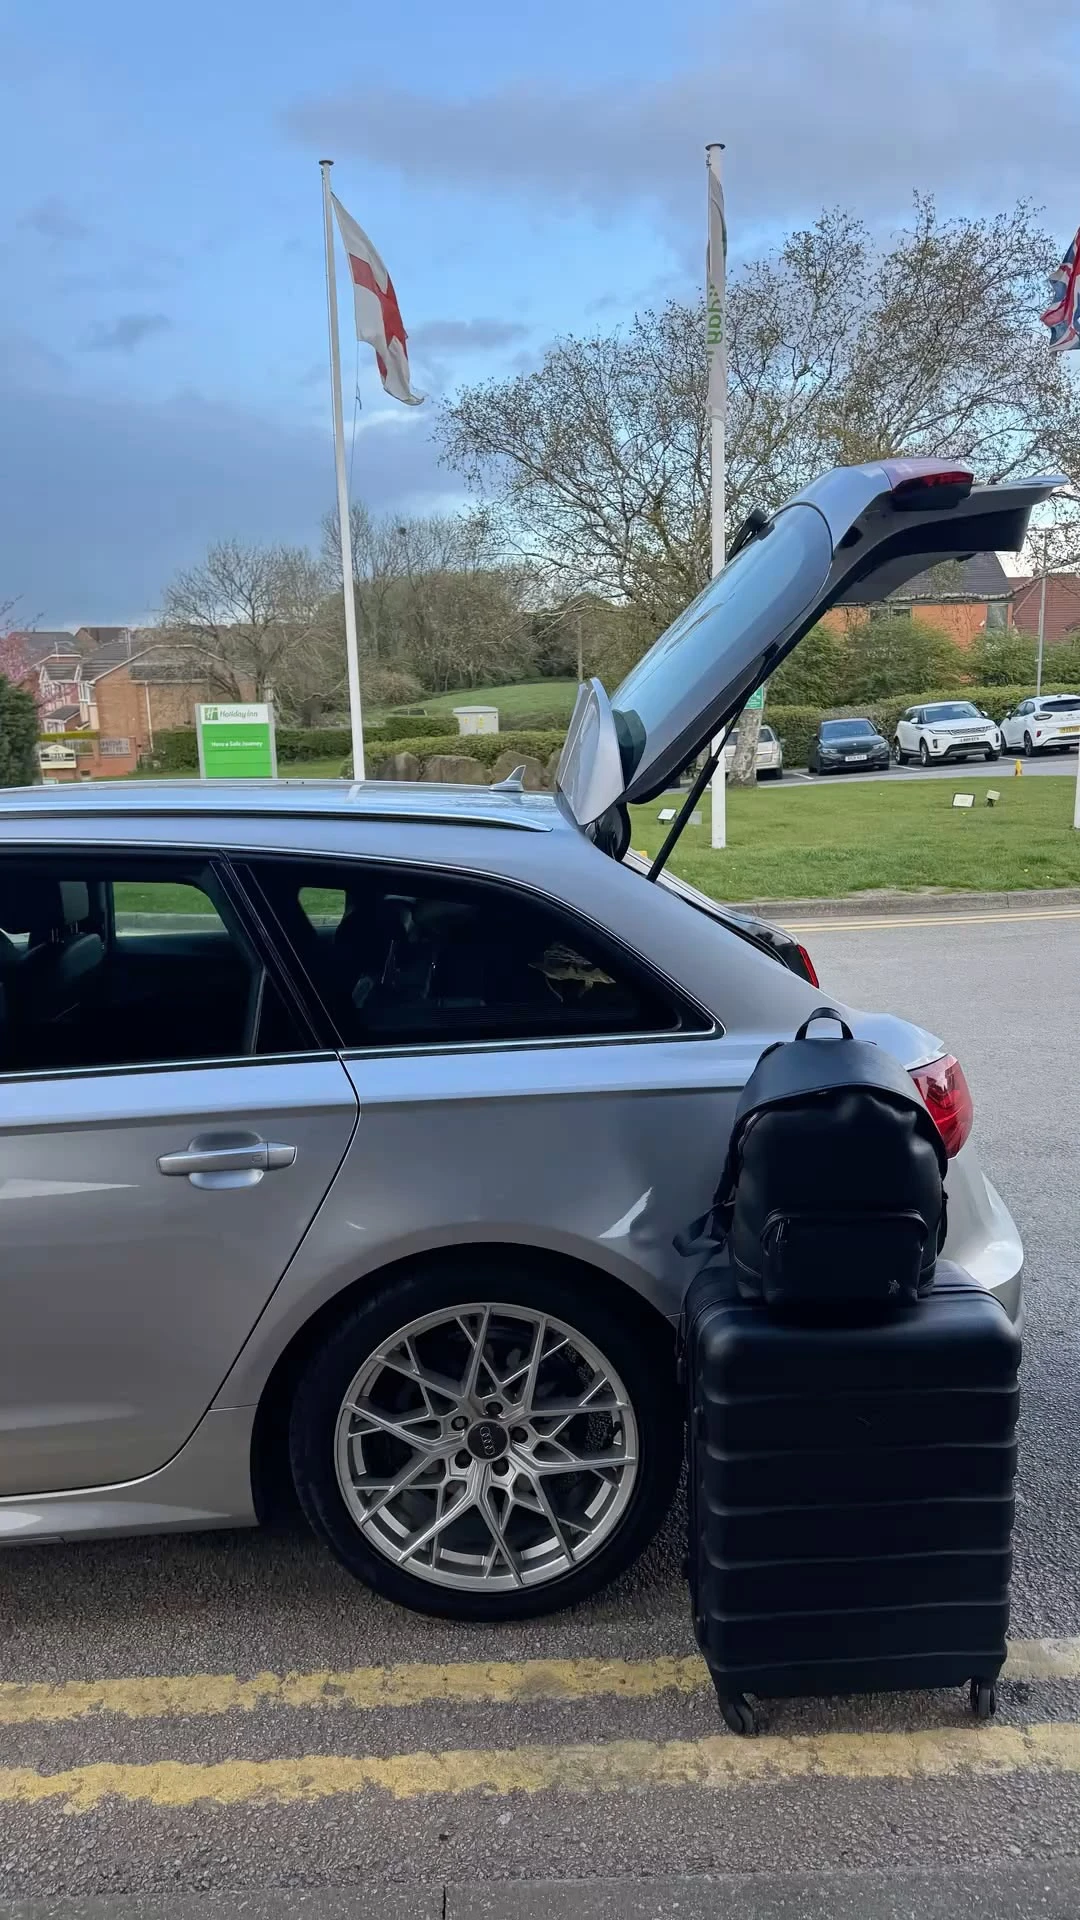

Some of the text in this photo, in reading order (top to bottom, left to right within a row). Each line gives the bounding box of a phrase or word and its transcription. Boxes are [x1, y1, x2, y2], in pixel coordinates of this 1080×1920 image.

[220, 709, 258, 718] Holiday Inn
[242, 740, 264, 748] Journey
